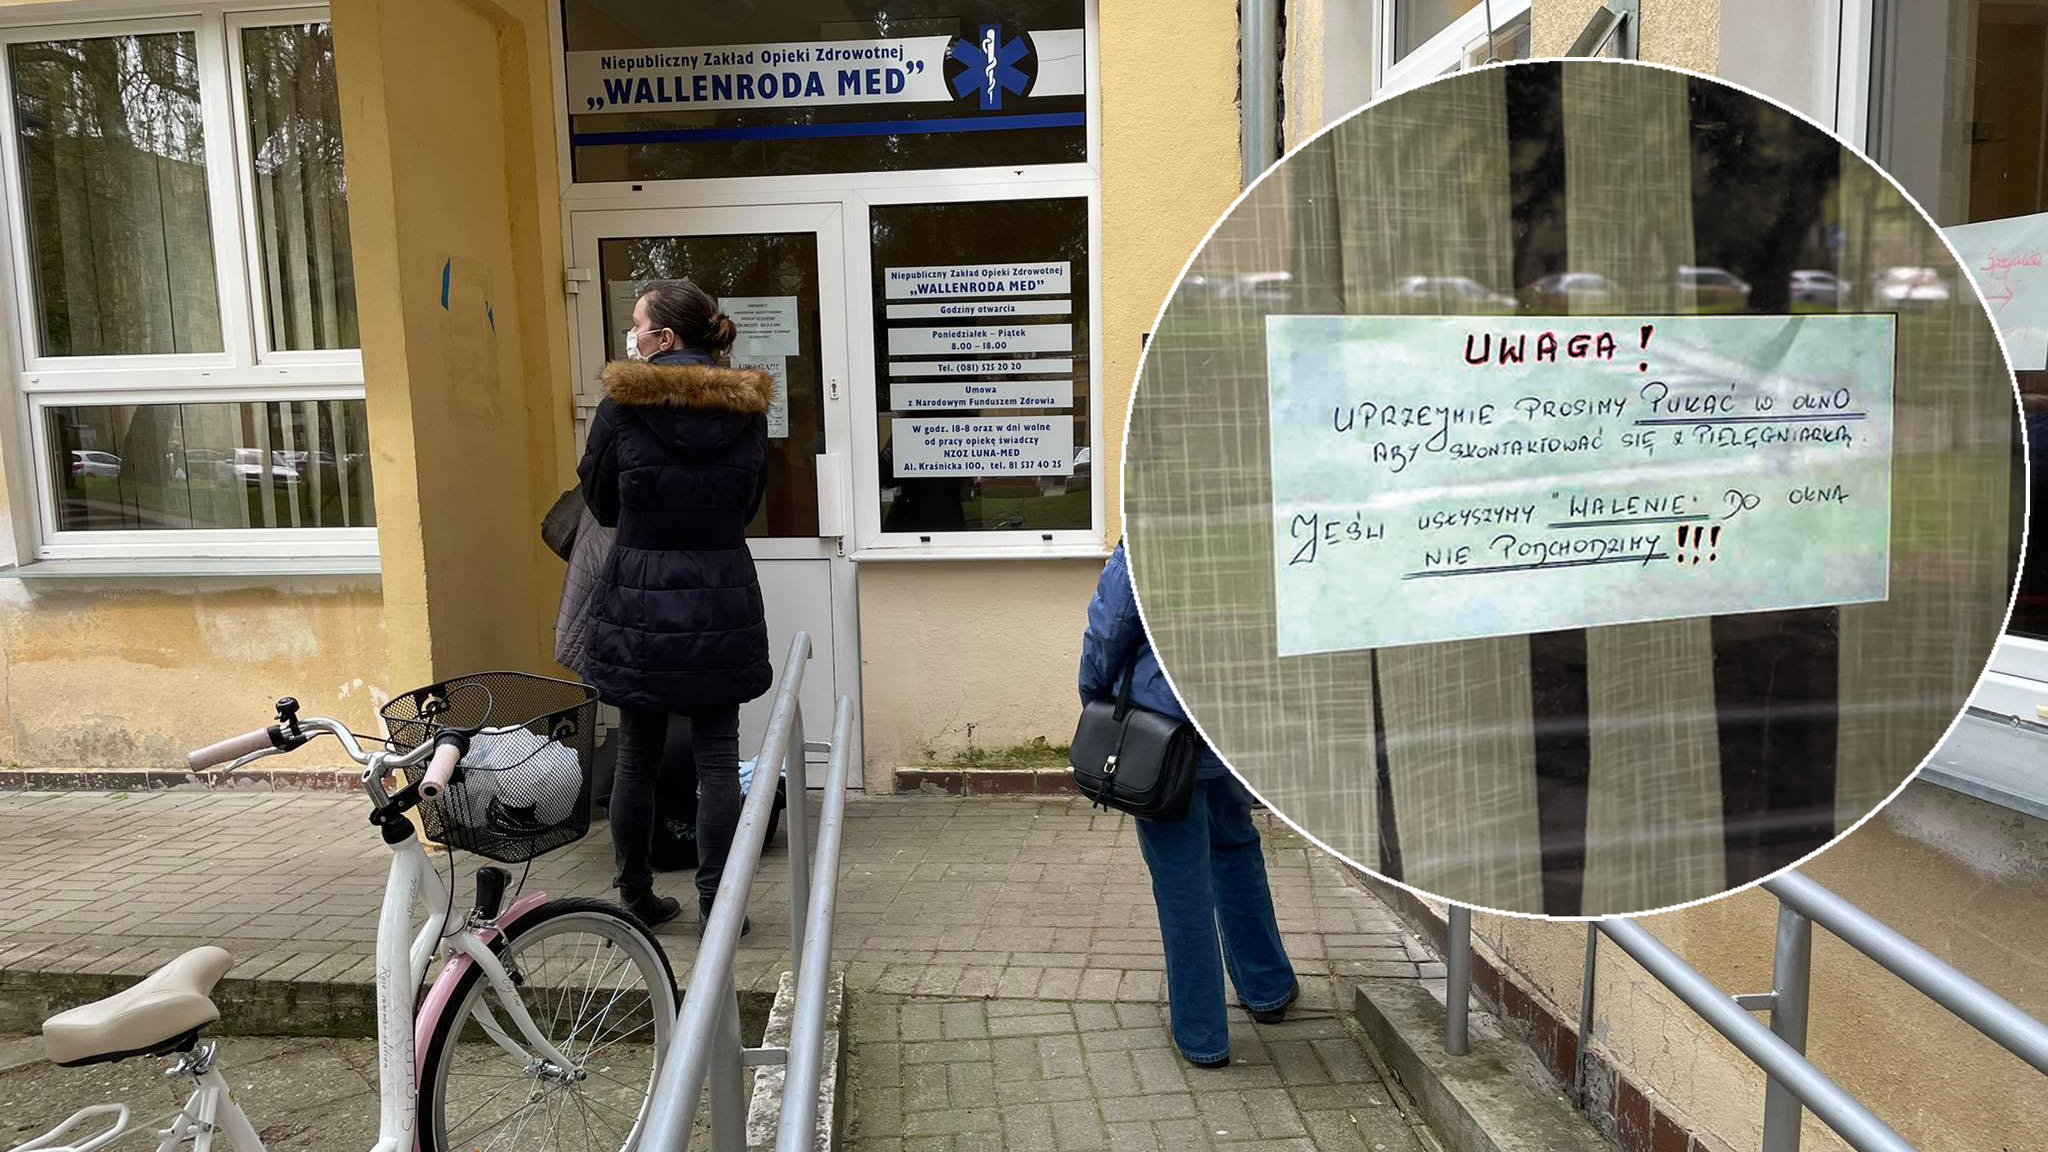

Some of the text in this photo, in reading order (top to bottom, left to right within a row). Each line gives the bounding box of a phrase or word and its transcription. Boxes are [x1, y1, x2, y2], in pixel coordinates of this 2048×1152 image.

[601, 44, 904, 72] Niepubliczny Zakład Opieki Zdrowotnej
[891, 267, 1063, 280] Niepubliczny Zakład Opieki Zdrowotnej
[940, 304, 1015, 315] Godziny otwarcia
[932, 330, 988, 339] Poniedziałek
[998, 329, 1026, 339] Piątek
[951, 342, 972, 350] 8.00
[1464, 332, 1617, 366] UWAGA
[938, 364, 953, 372] Tel.
[956, 363, 979, 372] (081)
[982, 363, 995, 371] 525
[998, 363, 1008, 371] 20
[965, 386, 997, 394] Umowa
[916, 399, 966, 408] Narodowym
[1020, 397, 1055, 405] Zdrowia
[924, 425, 949, 435] godz.
[973, 424, 993, 432] oraz
[1006, 423, 1021, 431] dni
[1024, 423, 1051, 431] wolne
[1333, 402, 1494, 452] UPRZEJMIE
[1514, 396, 1627, 420] PROSIMY
[939, 438, 963, 447] pracy
[966, 436, 996, 446] opiekę
[999, 436, 1039, 446] świadczy
[1373, 442, 1420, 473] ABY
[1622, 432, 1656, 457] SIĘ
[904, 463, 916, 471] Al.
[919, 462, 962, 470] Kraśnicka
[990, 461, 1006, 469] tel.
[1009, 461, 1017, 469] 81
[1021, 461, 1034, 469] 537
[1052, 460, 1062, 468] 25
[1289, 511, 1384, 566] JEŚLI
[1722, 489, 1760, 520] DO
[1425, 546, 1471, 566] NIE
[401, 1039, 417, 1132] Storm
